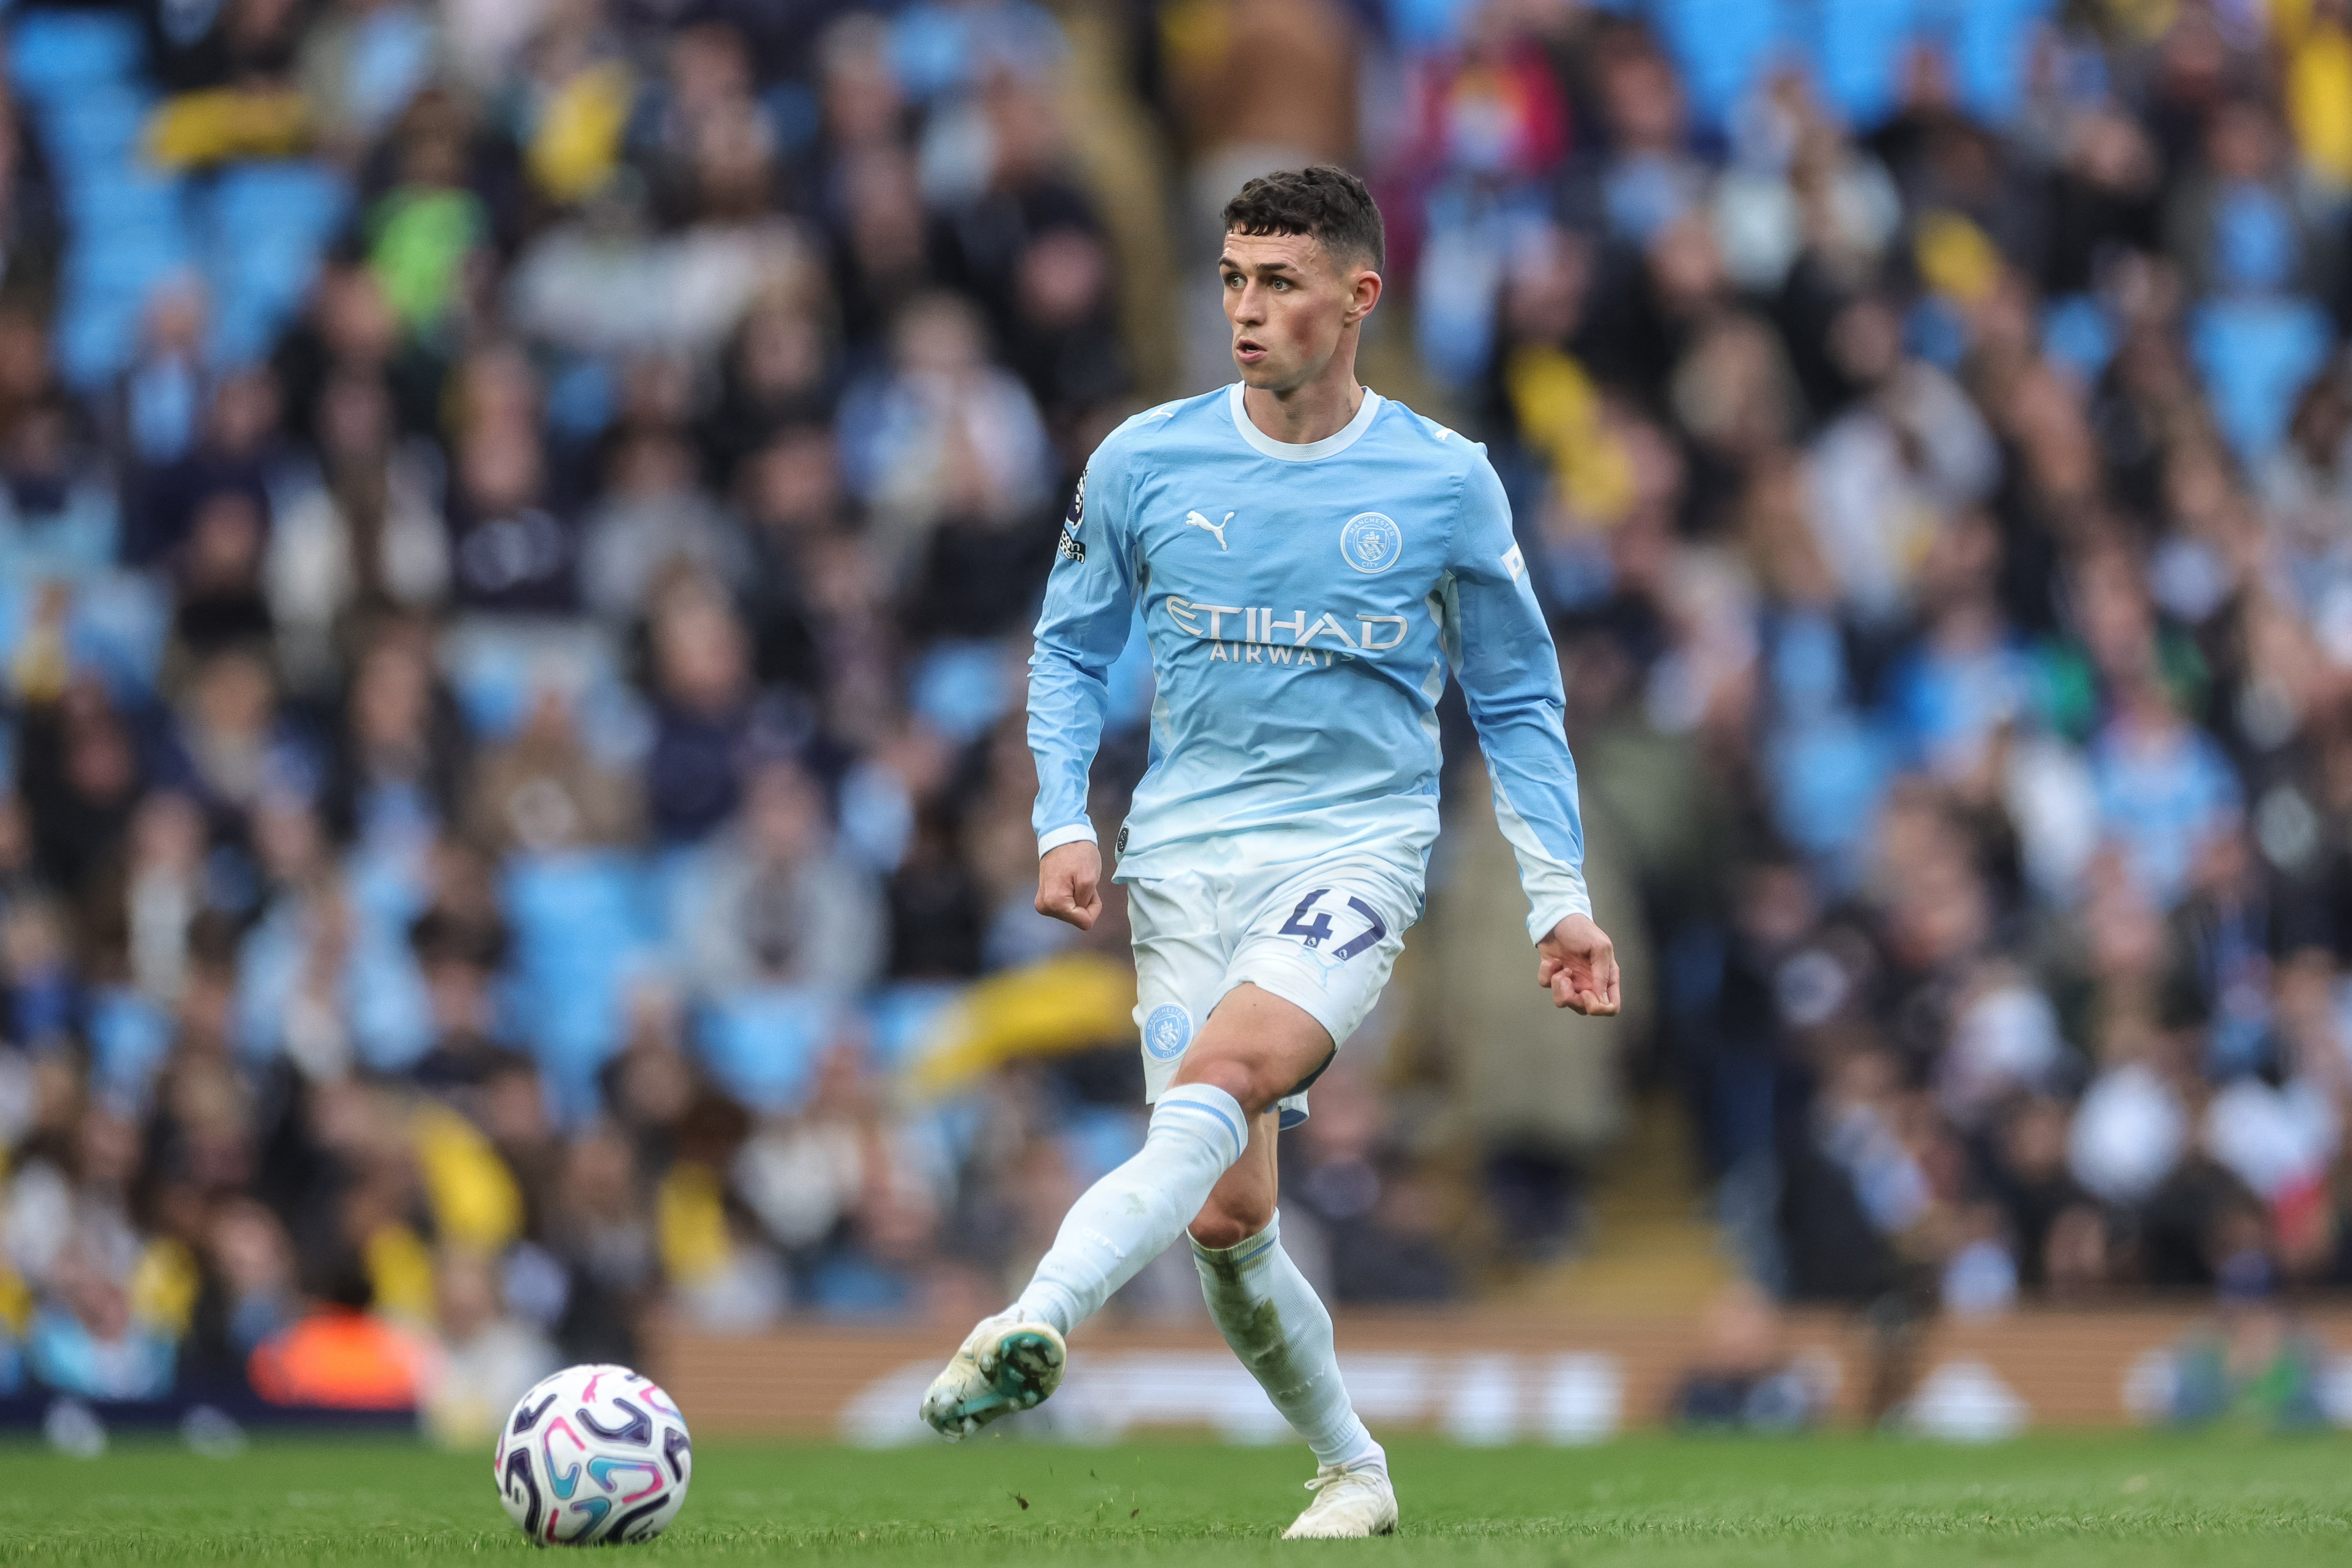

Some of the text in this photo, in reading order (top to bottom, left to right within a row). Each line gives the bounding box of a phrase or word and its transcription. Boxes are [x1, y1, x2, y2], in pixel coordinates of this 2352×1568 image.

[1349, 518, 1395, 537] MANCHESTER
[1166, 595, 1408, 650] ETIHAD
[1278, 889, 1387, 962] 47
[1148, 1007, 1186, 1030] MANCHESTER
[1163, 1048, 1177, 1057] CITY
